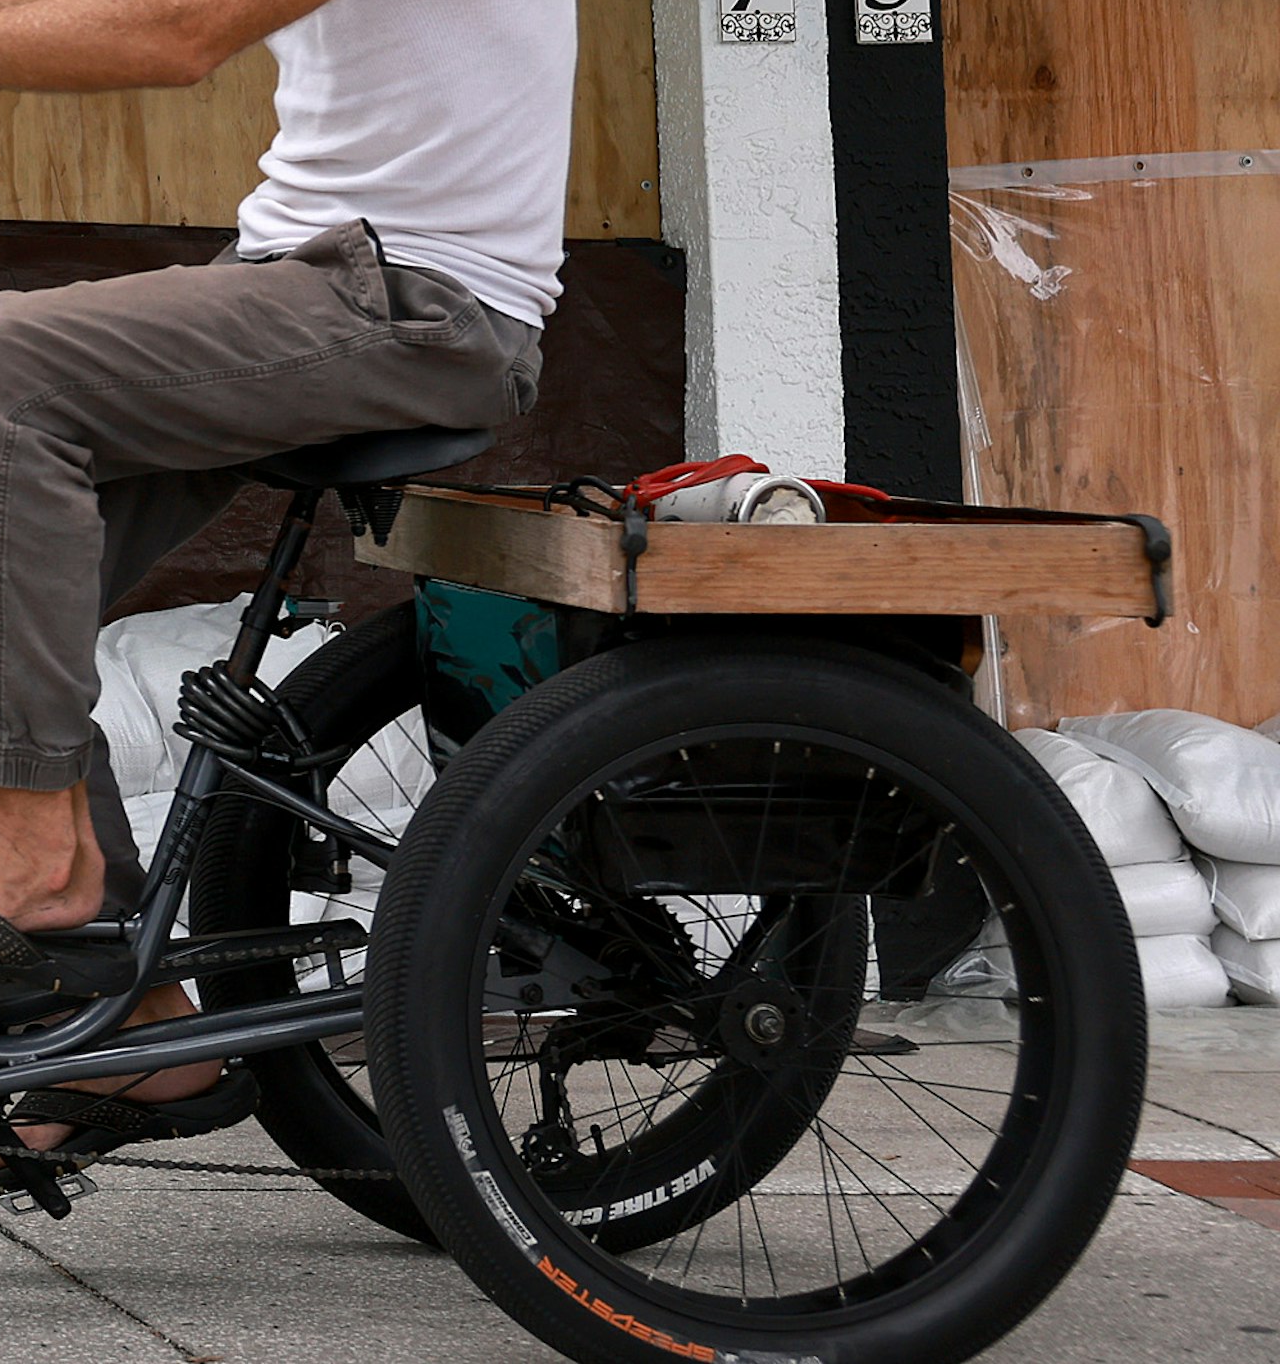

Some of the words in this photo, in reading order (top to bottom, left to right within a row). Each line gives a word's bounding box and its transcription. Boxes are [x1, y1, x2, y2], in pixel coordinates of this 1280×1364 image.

[669, 1157, 717, 1198] VEE
[608, 1185, 671, 1221] TIRE
[535, 1254, 717, 1364] SPEEDSTER
